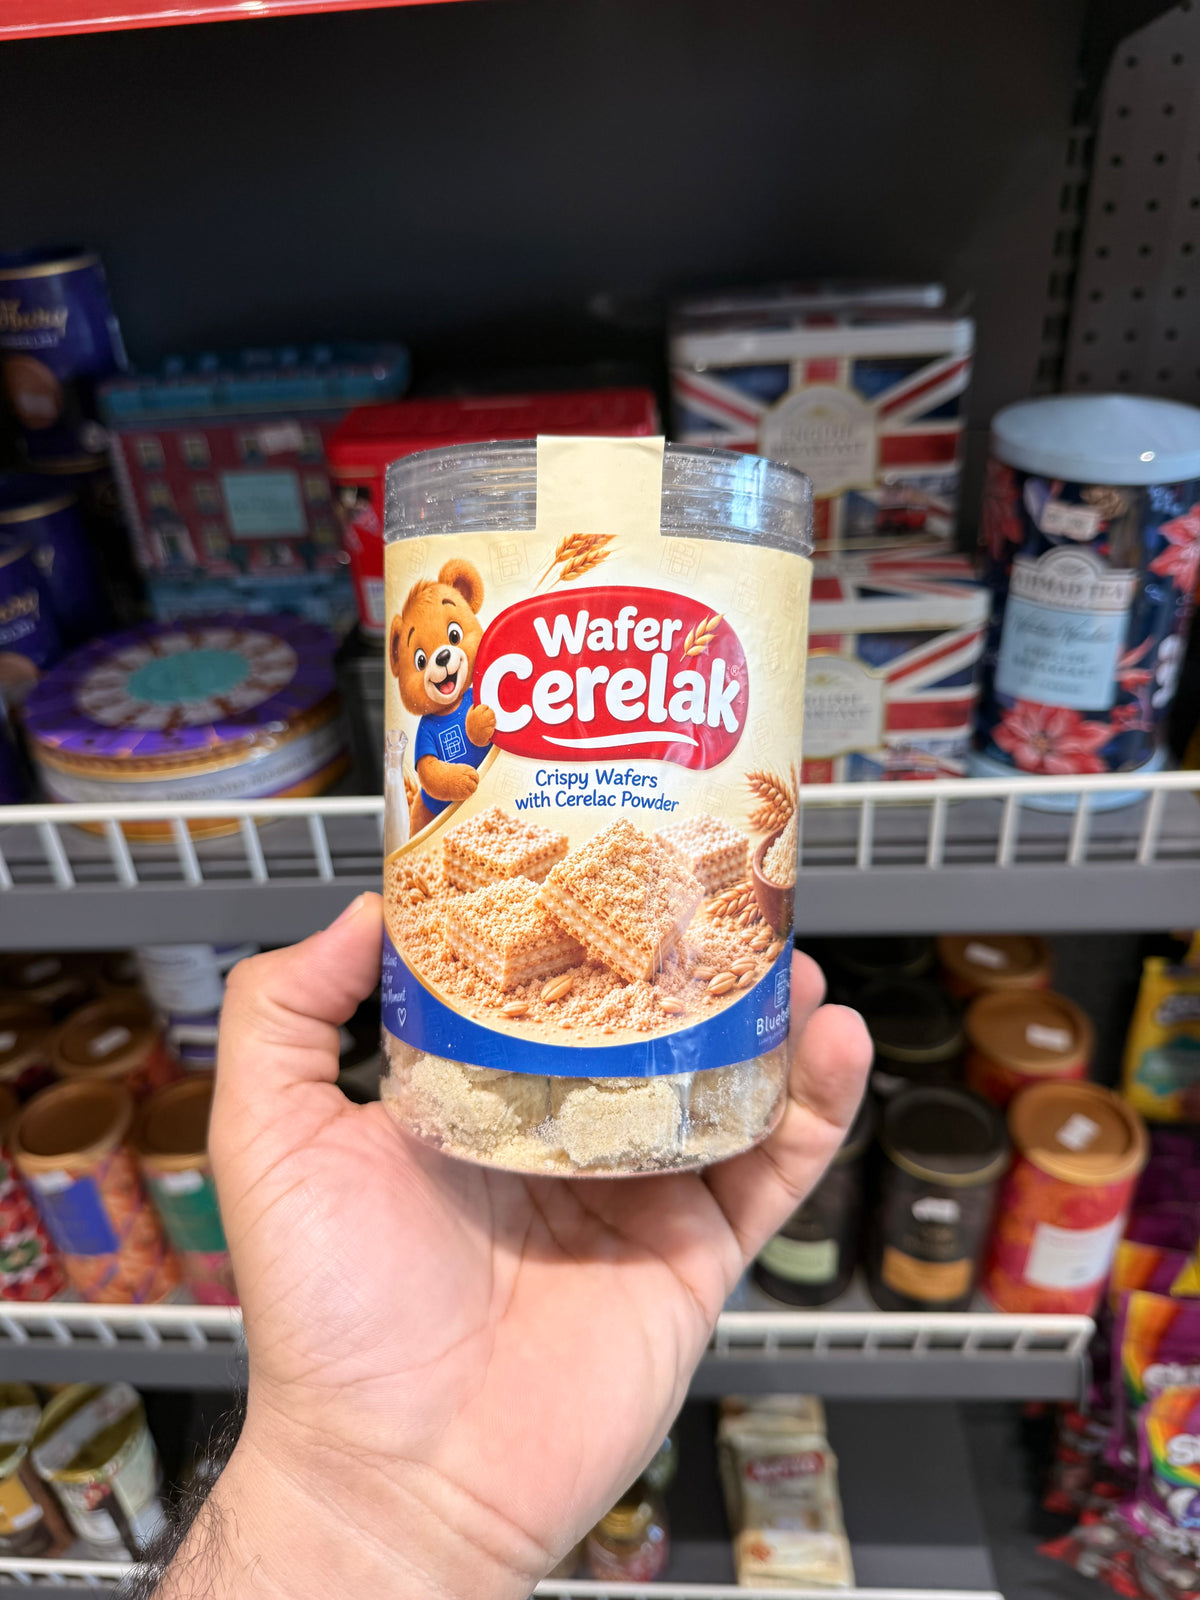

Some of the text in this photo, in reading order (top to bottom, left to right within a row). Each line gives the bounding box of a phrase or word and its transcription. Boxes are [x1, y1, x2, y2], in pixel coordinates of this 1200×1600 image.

[533, 606, 683, 658] Wafer
[480, 653, 740, 734] Cerelak
[535, 768, 658, 790] Crispy Wafers
[515, 789, 679, 812] with Cerelac Powder
